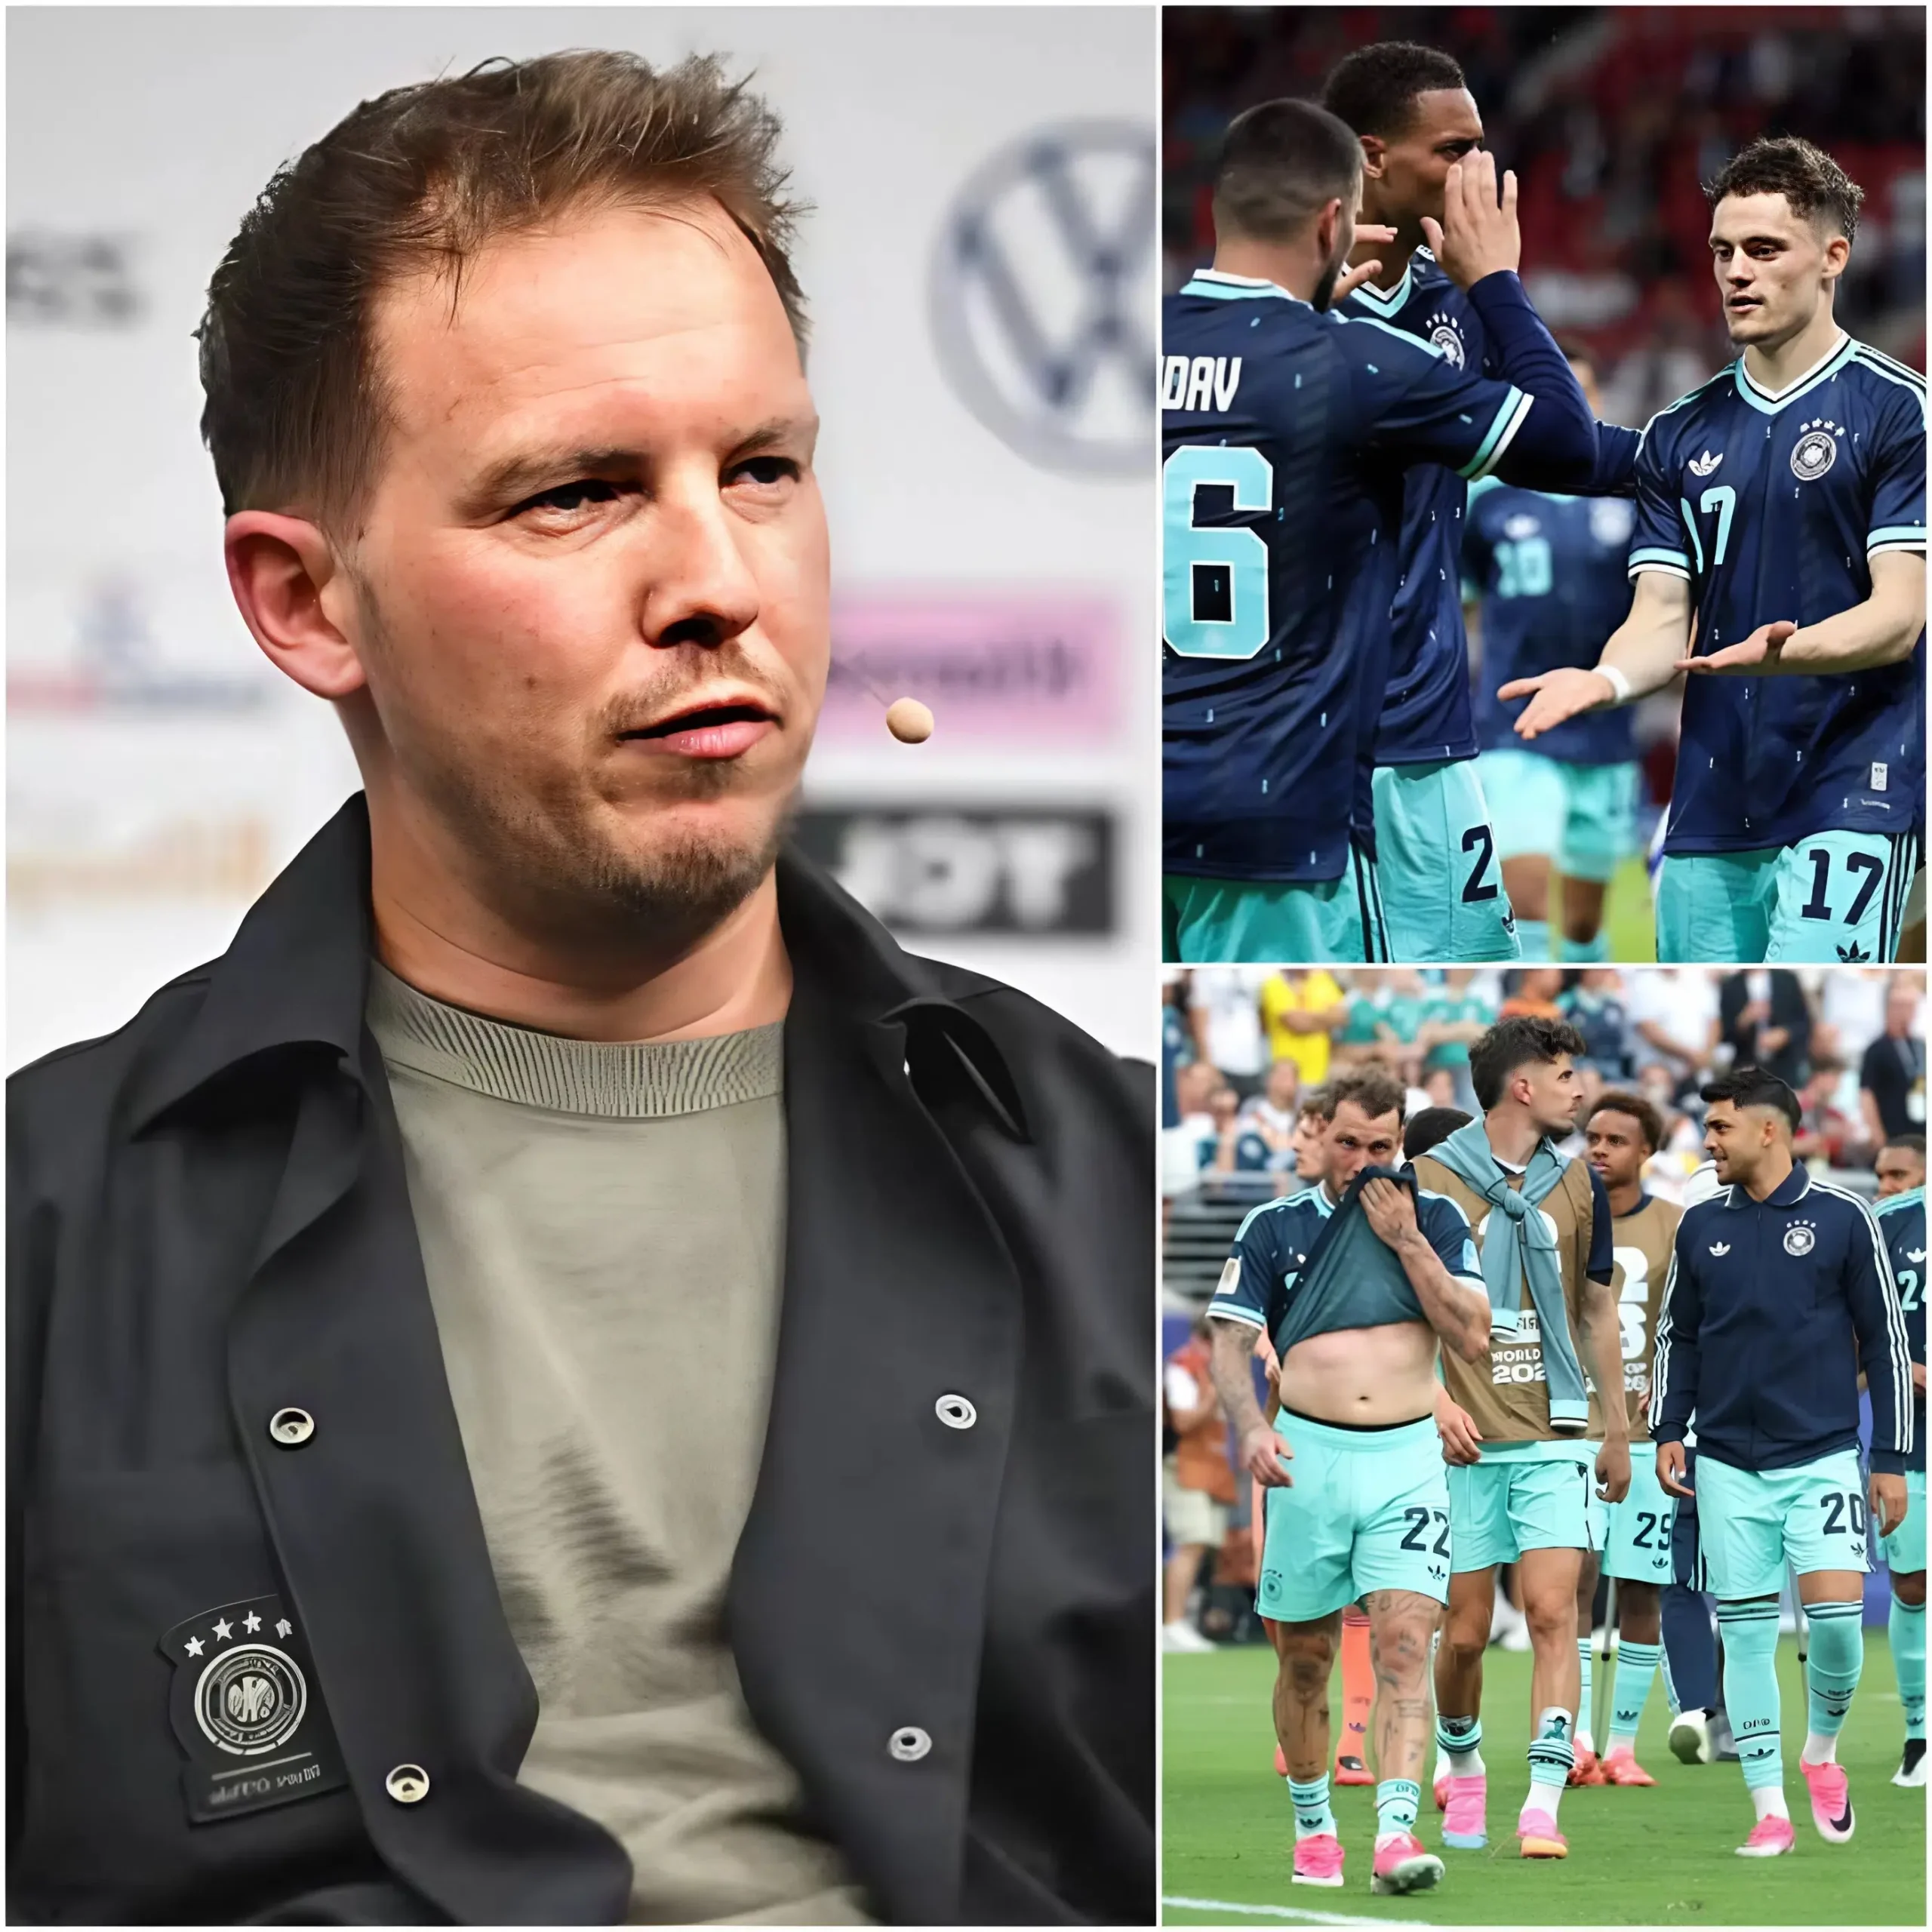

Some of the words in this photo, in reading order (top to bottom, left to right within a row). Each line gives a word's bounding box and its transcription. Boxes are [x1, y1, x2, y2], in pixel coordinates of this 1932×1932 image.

[1161, 355, 1242, 412] DAV
[1163, 445, 1273, 659] 6
[1462, 825, 1497, 903] 2
[1801, 848, 1884, 925] 17
[1897, 1269, 1926, 1310] 2
[1491, 1348, 1540, 1362] WORLD
[1400, 1507, 1450, 1559] 22
[1820, 1492, 1865, 1536] 20
